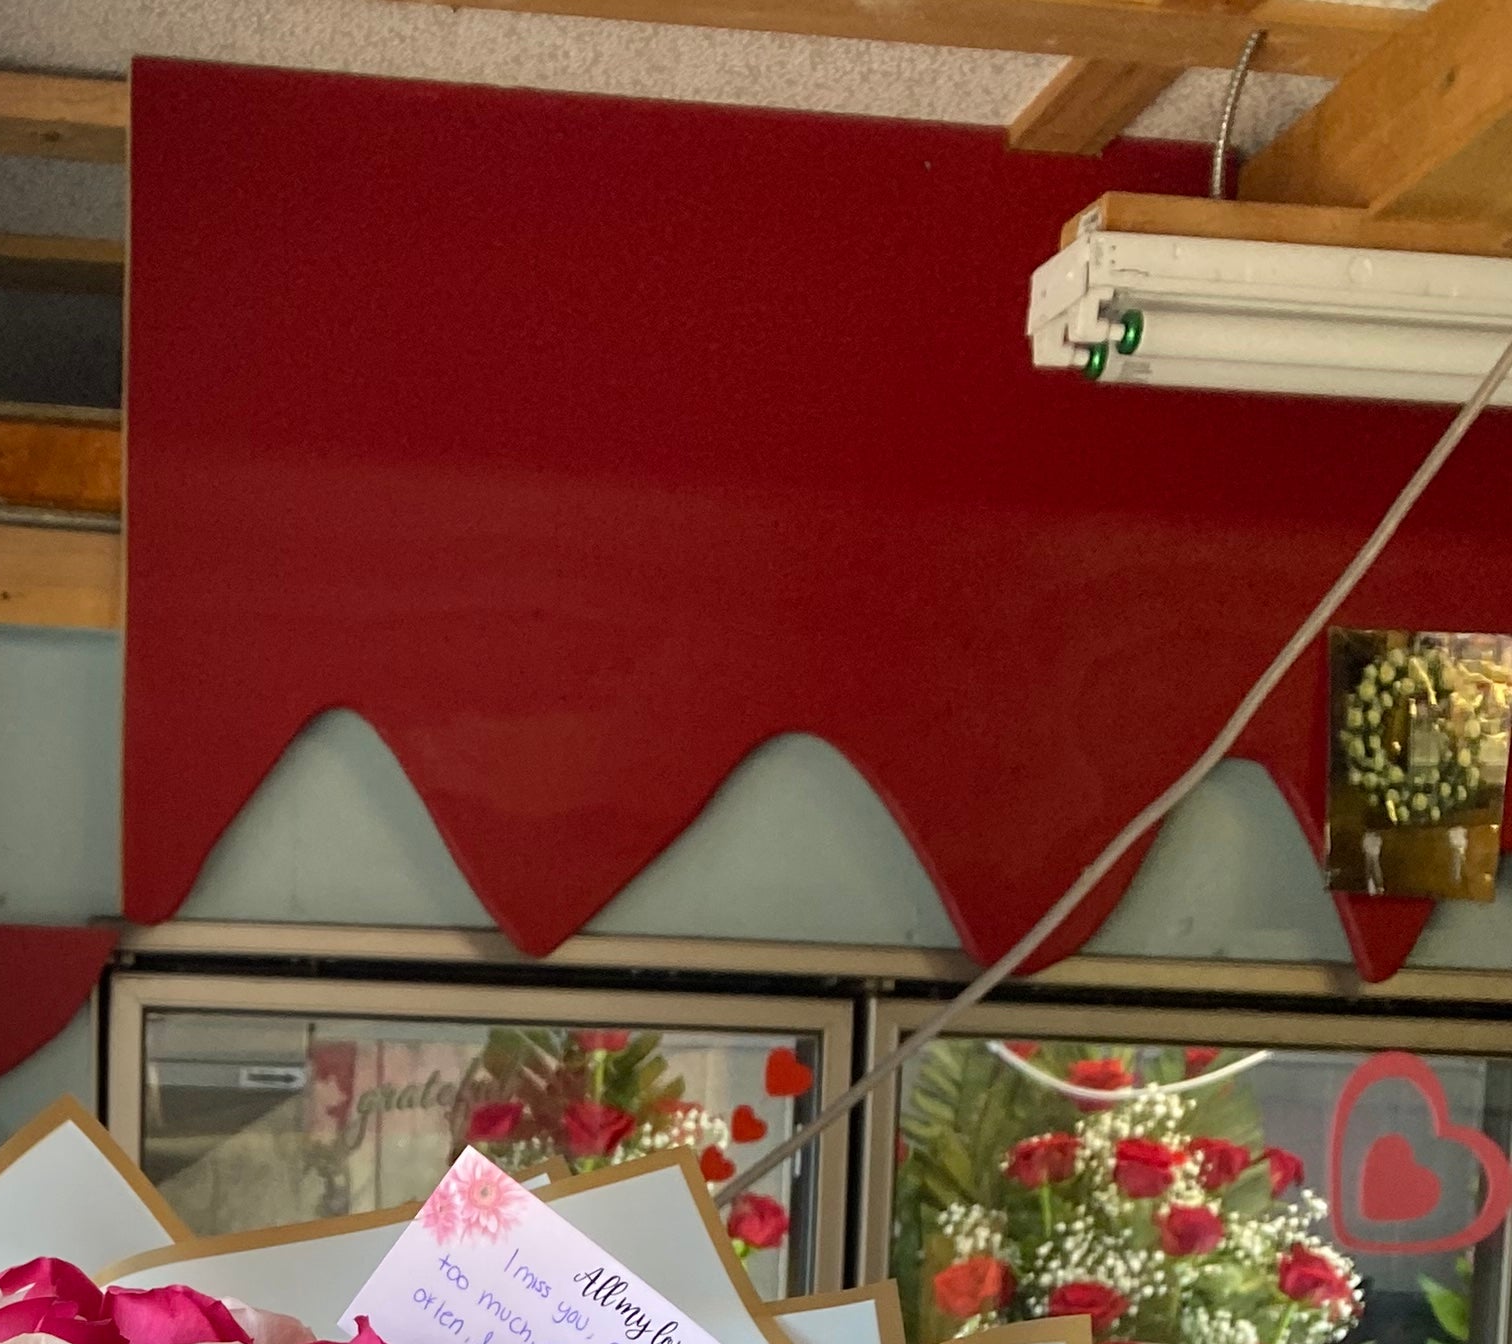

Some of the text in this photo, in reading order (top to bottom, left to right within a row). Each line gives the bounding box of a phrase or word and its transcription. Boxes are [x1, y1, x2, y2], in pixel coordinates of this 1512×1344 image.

[438, 1253, 470, 1291] too
[504, 1248, 520, 1273] I
[513, 1265, 553, 1298] miss
[573, 1267, 629, 1307] All
[615, 1296, 654, 1341] my
